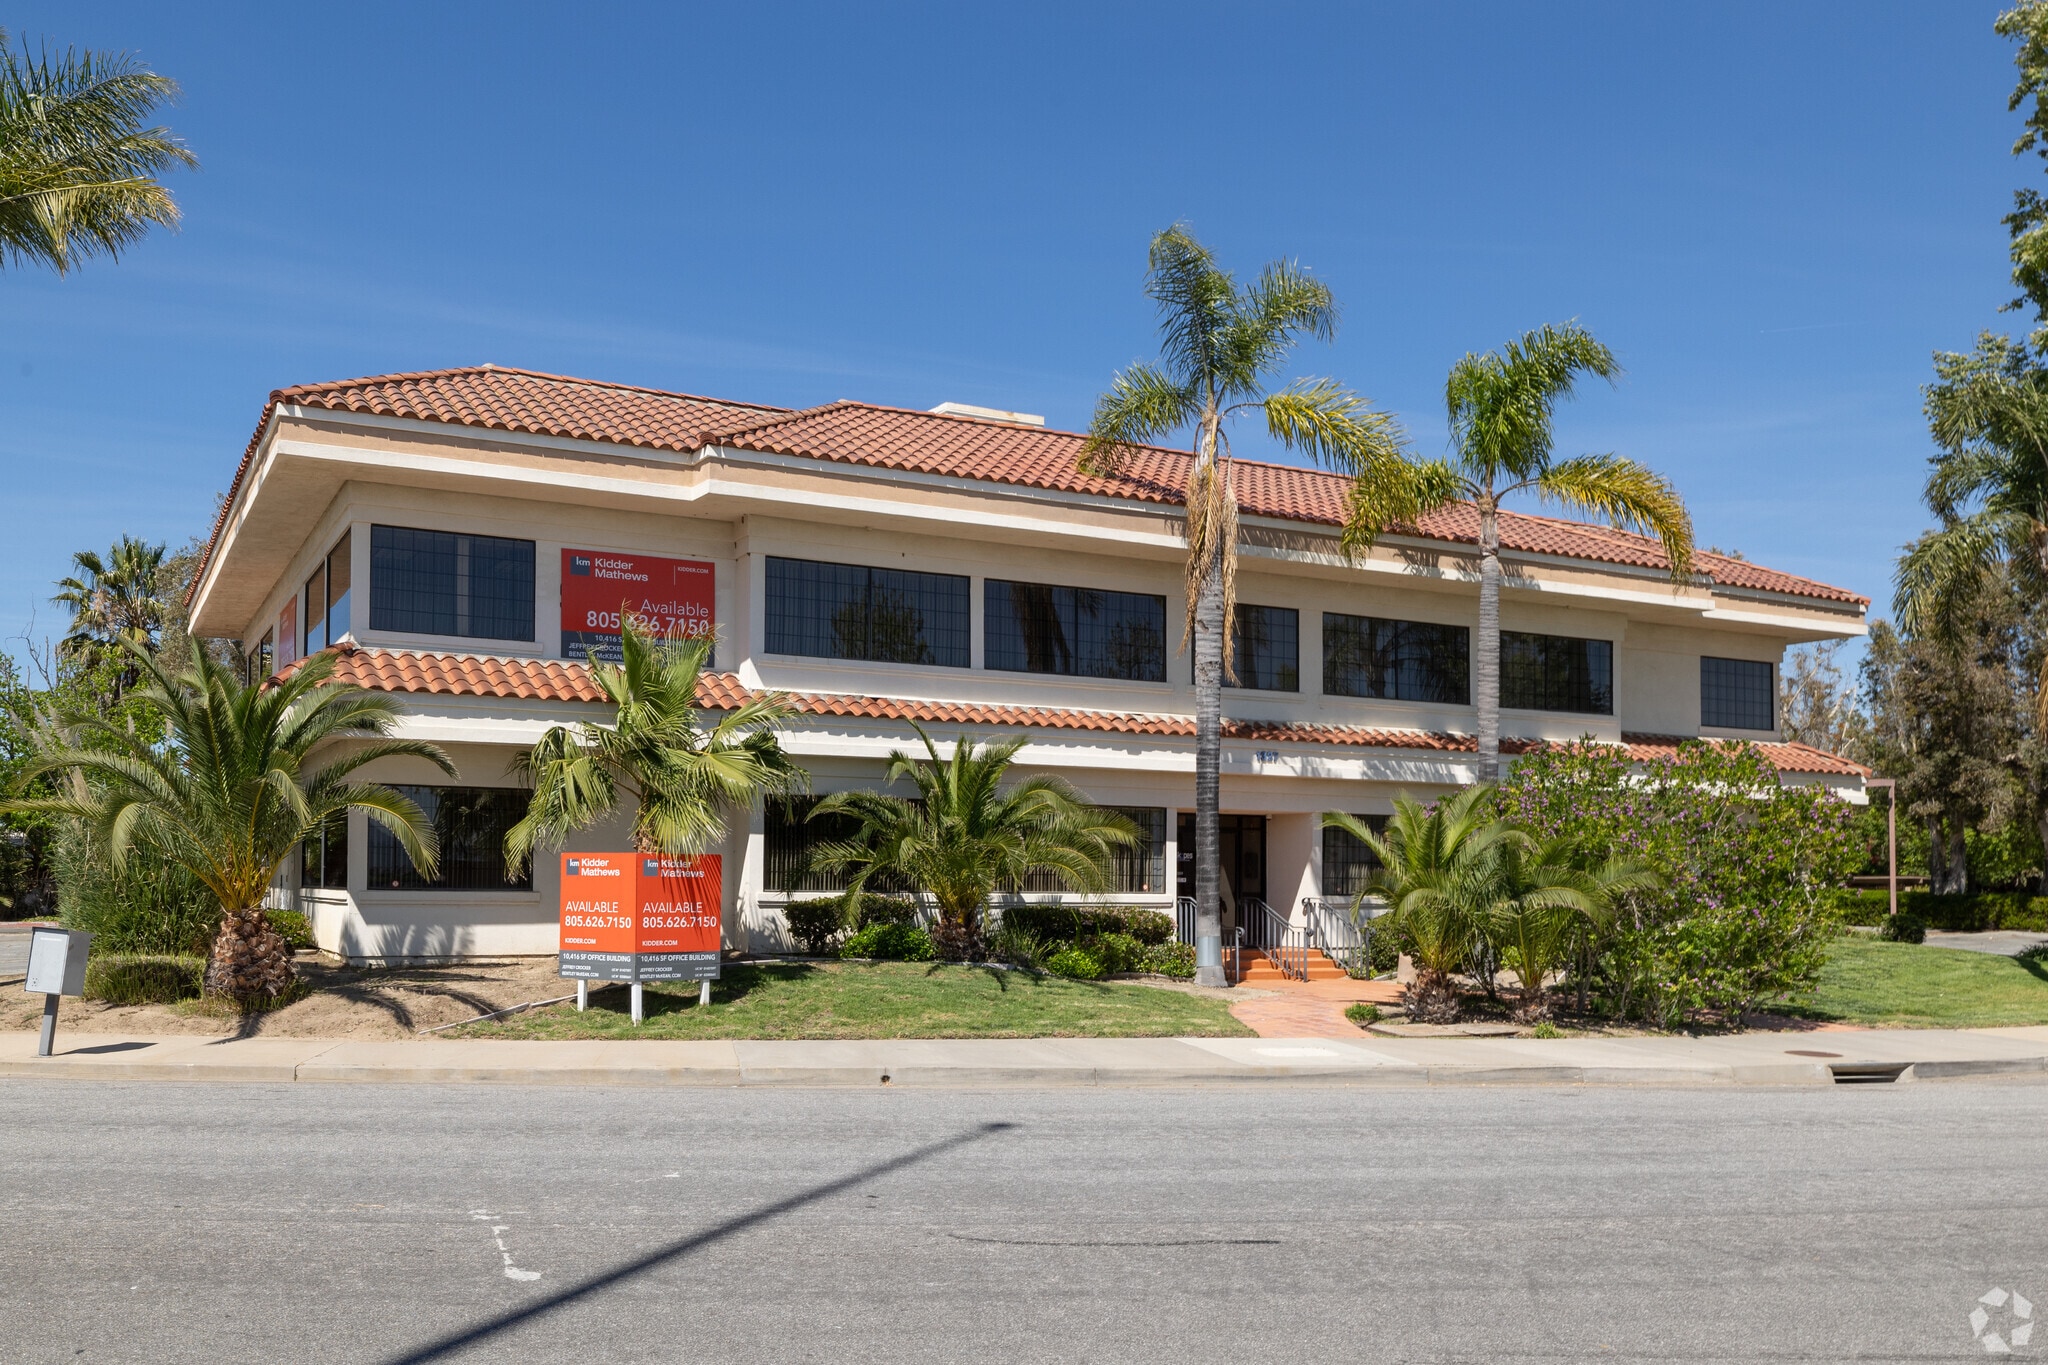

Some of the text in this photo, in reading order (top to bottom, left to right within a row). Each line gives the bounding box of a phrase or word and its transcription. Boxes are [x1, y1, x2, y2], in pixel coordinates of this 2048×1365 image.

[595, 558, 634, 570] Kidder
[677, 566, 709, 574] KIDDER.COM
[595, 568, 649, 582] Mathews
[640, 598, 709, 617] Available
[595, 635, 617, 643] 10,416
[581, 858, 609, 867] Kidder
[661, 859, 692, 868] Kidder
[581, 868, 620, 876] Mathews
[661, 869, 705, 878] Mathews
[565, 901, 618, 913] AVAILABLE
[643, 902, 703, 914] AVAILABLE
[565, 916, 632, 928] 805.626.7150
[642, 916, 717, 928] 805.626.7150
[642, 939, 678, 947] KIDDER.COM
[587, 954, 606, 962] OFFICE
[606, 955, 631, 963] BUILDING
